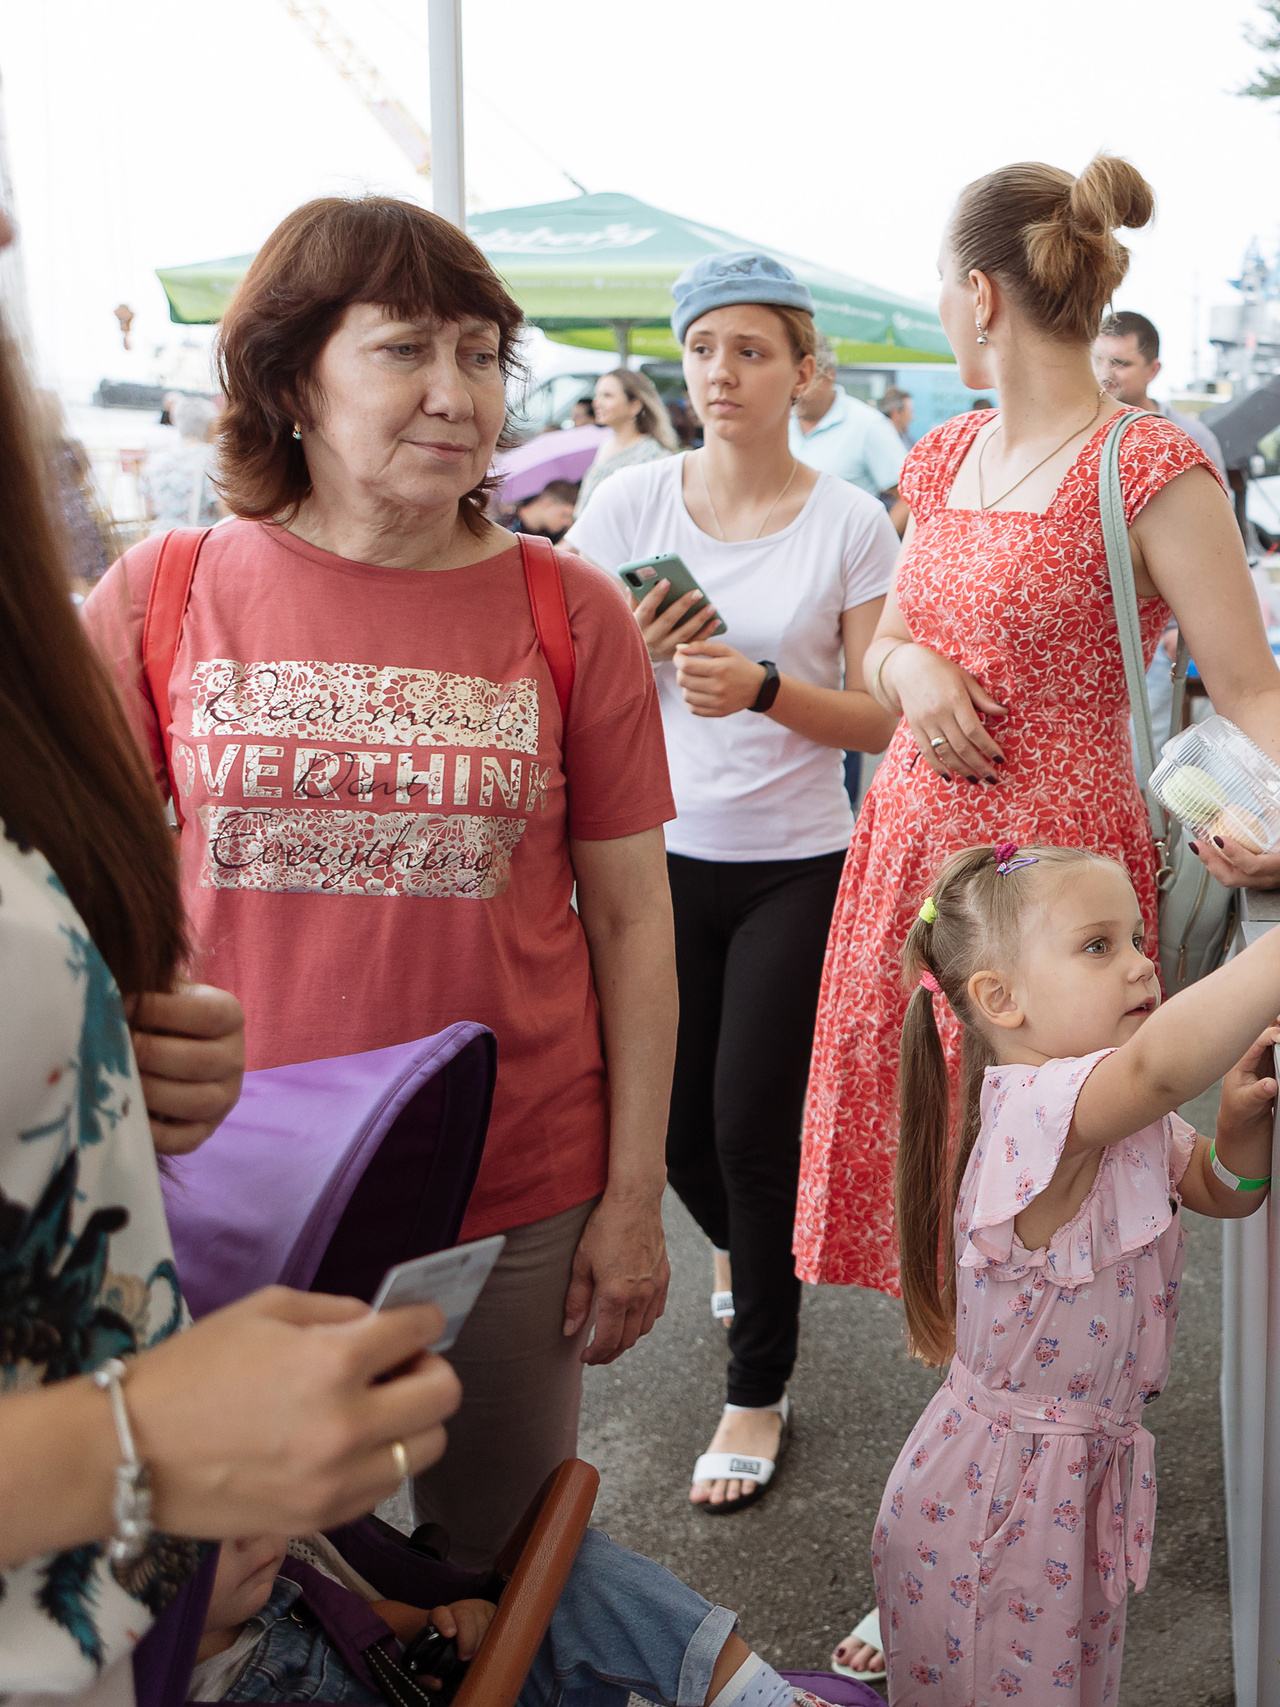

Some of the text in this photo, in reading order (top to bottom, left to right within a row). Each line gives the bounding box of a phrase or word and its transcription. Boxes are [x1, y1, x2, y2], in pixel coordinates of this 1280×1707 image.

[204, 669, 361, 722] Dear
[174, 743, 553, 813] OVERTHINK
[210, 811, 493, 893] Everything
